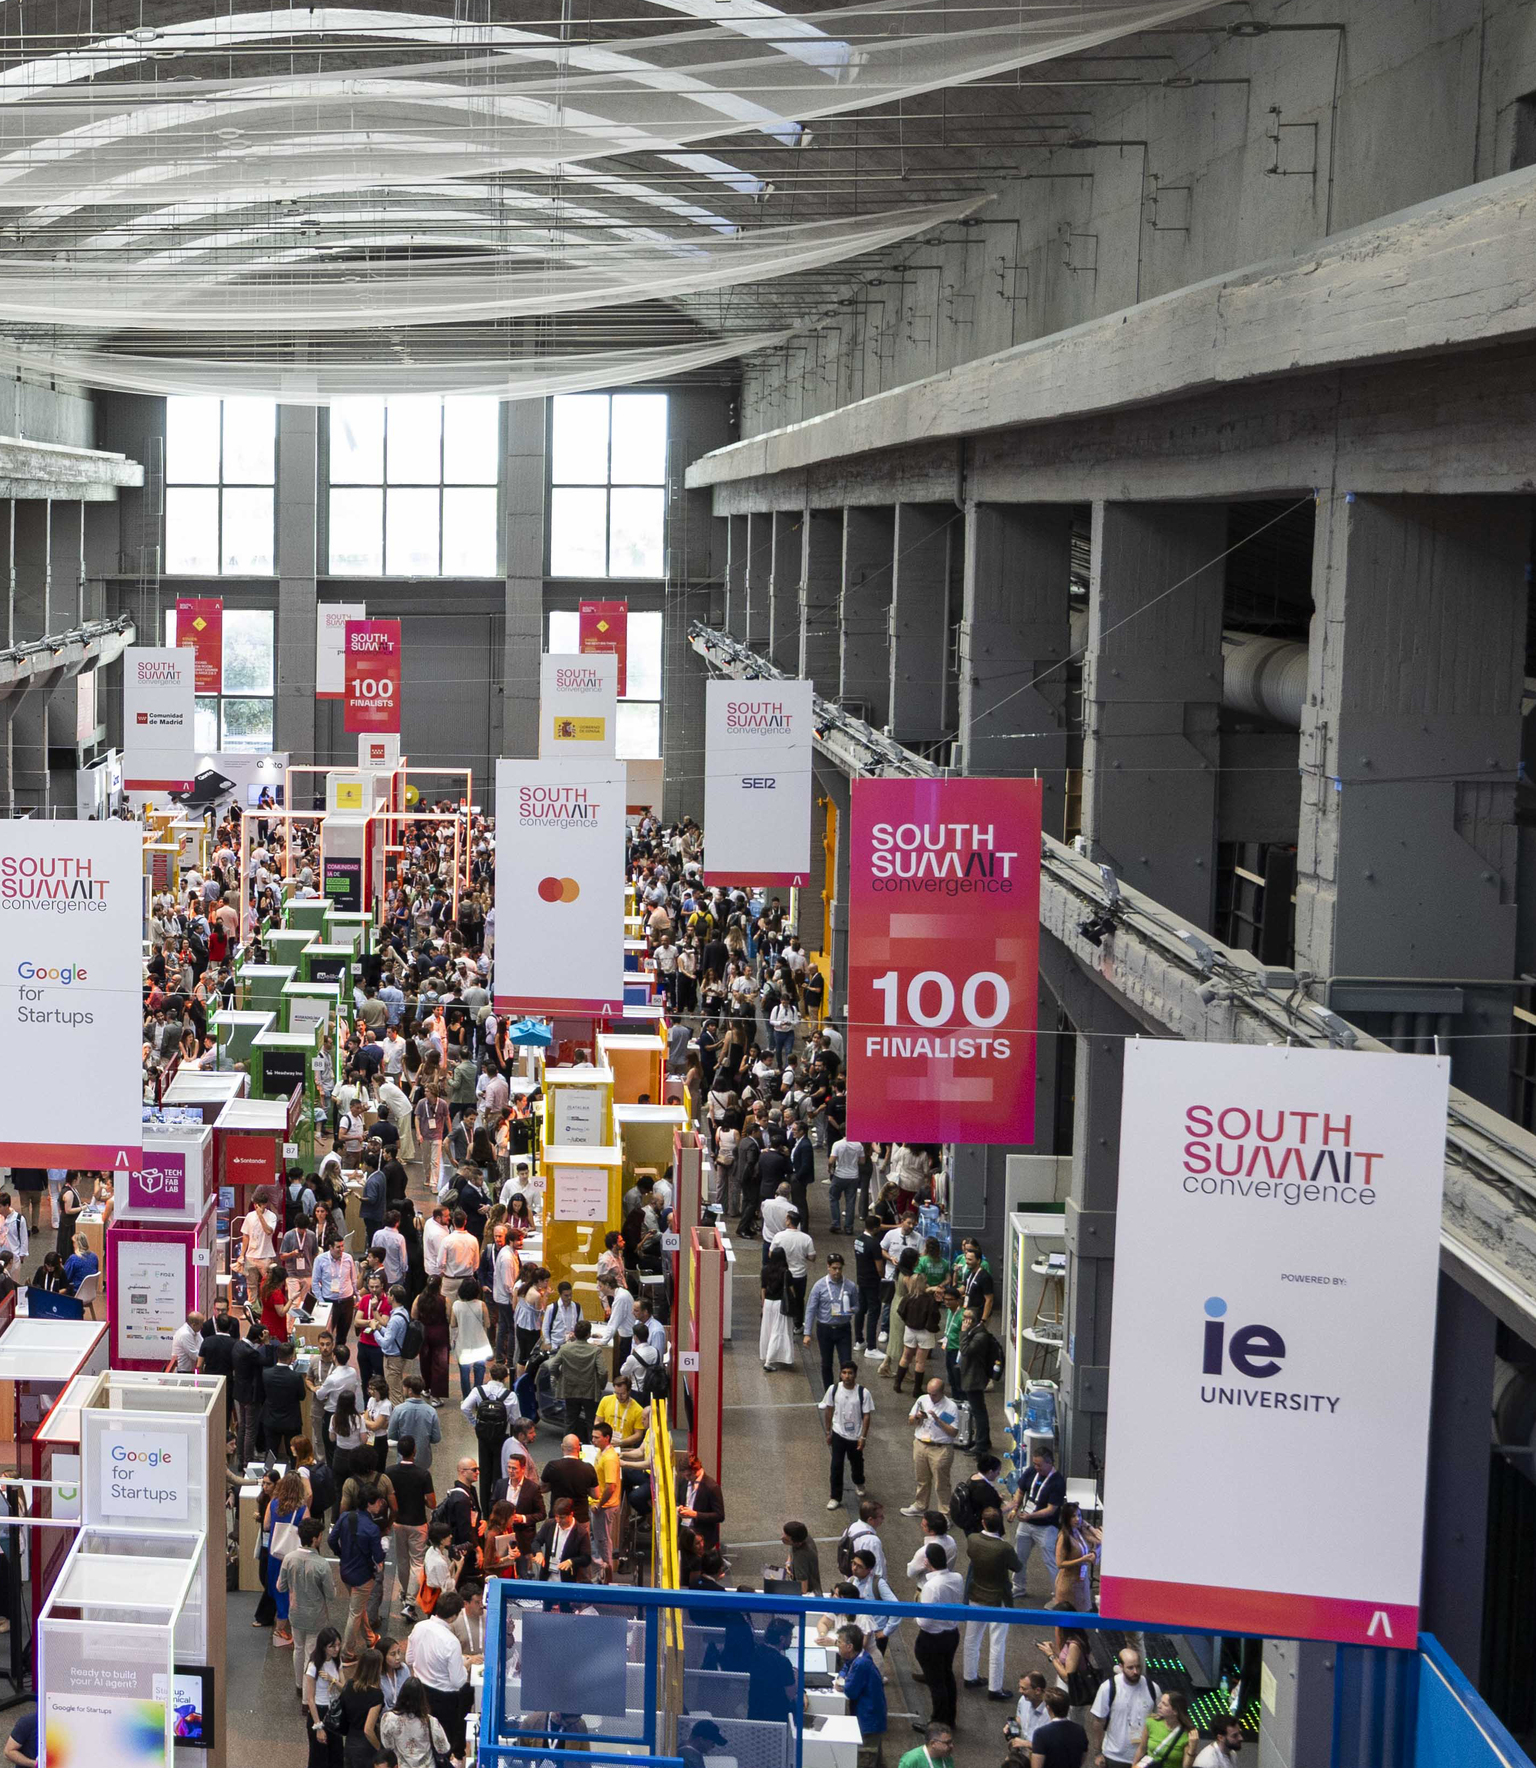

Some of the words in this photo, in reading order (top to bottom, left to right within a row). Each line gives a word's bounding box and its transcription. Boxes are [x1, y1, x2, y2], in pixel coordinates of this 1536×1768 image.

[351, 634, 387, 642] SOUTH
[351, 642, 394, 651] SUMMIT
[138, 662, 175, 670] SOUTH
[556, 669, 596, 678] SOUTH
[138, 671, 181, 680] SUMMIT
[556, 678, 603, 687] SUMMIT
[352, 679, 393, 697] 100
[556, 686, 602, 694] convergence
[727, 702, 782, 714] SOUTH
[726, 715, 792, 727] SUMMIT
[726, 727, 791, 736] convergence
[742, 778, 776, 789] SER
[519, 786, 587, 803] SOUTH
[519, 802, 600, 819] SUMMIT
[519, 817, 598, 830] convergence
[872, 823, 994, 851] SOUTH
[1, 856, 92, 878] SOUTH
[871, 852, 1018, 878] SUMMIT
[1, 878, 110, 900] SUMMIT
[872, 877, 1012, 896] convergence
[2, 898, 107, 914] convergence
[18, 962, 88, 984] Google
[18, 985, 44, 1000] for
[872, 971, 1010, 1028] 100
[18, 1006, 94, 1028] Startups
[866, 1037, 1010, 1059] FINALISTS
[1184, 1105, 1352, 1147] SOUTH
[1183, 1141, 1384, 1185] SUMMIT
[1183, 1176, 1376, 1206] convergence
[1281, 1274, 1330, 1284] POWERED
[1202, 1296, 1286, 1378] ie
[1201, 1386, 1340, 1414] UNIVERSITY
[112, 1446, 171, 1466] Google
[112, 1465, 134, 1480] for
[111, 1484, 177, 1504] Startups
[71, 1667, 98, 1678] Ready
[113, 1670, 136, 1680] build
[70, 1678, 91, 1686] your
[105, 1680, 137, 1689] agent?
[52, 1704, 75, 1713] Google
[86, 1706, 112, 1714] Startups
